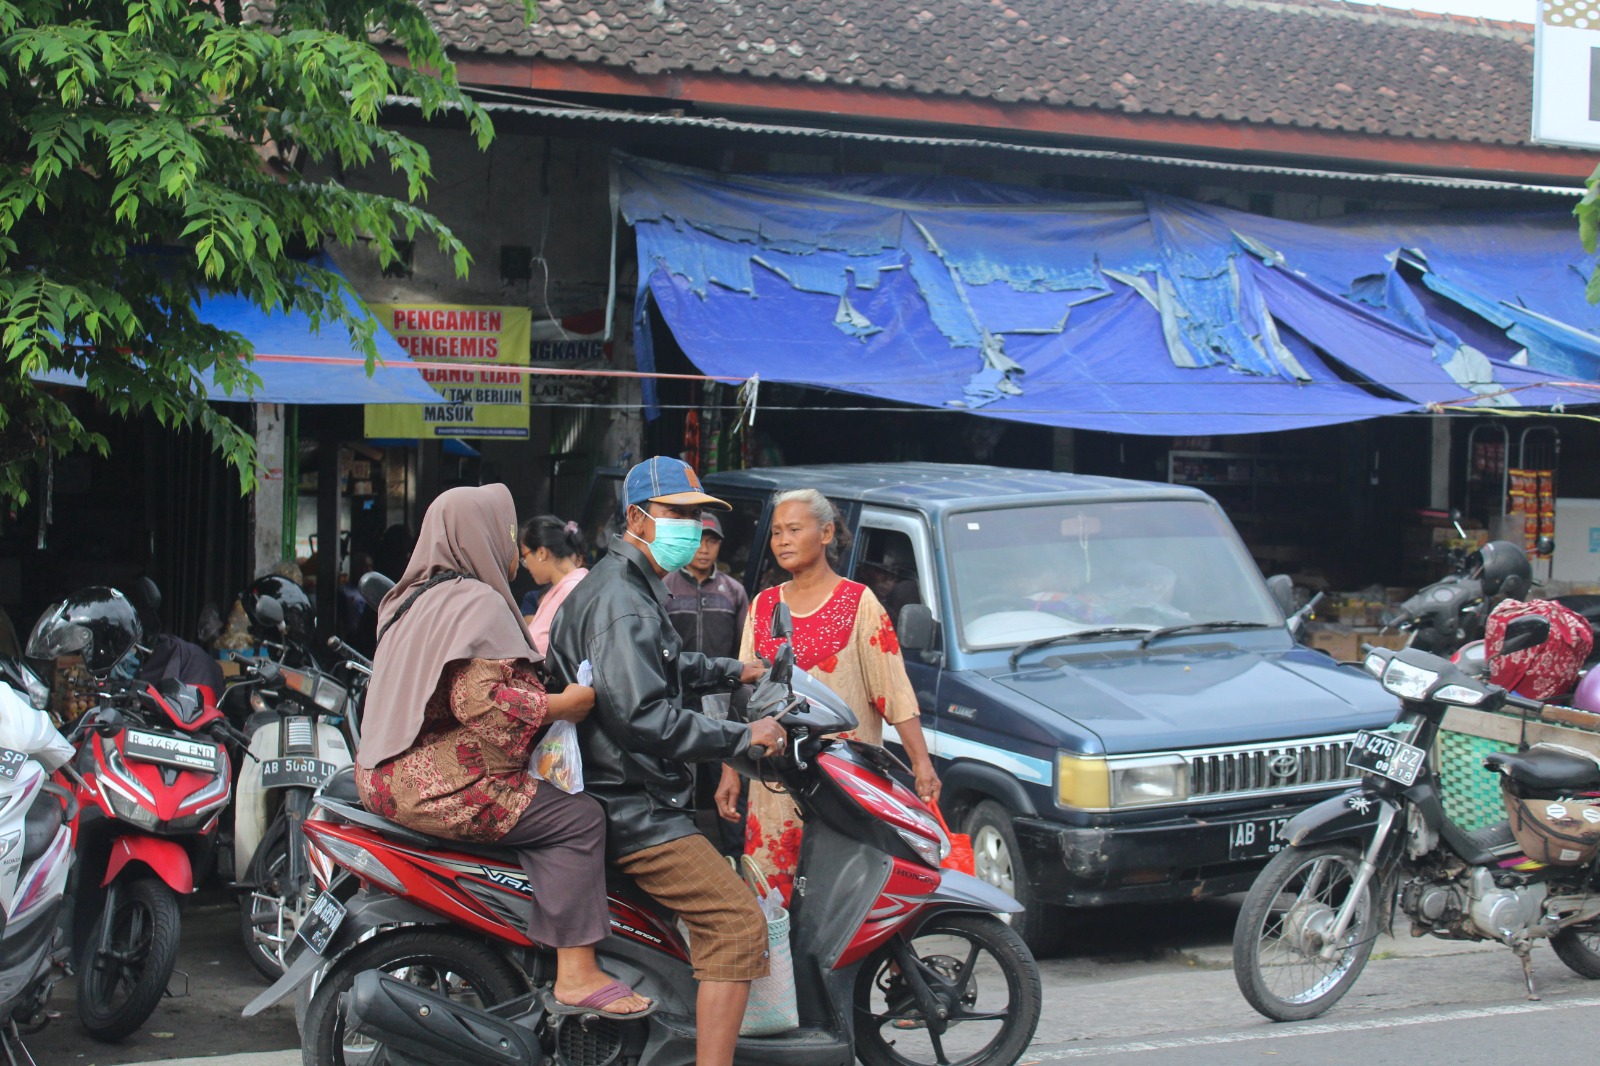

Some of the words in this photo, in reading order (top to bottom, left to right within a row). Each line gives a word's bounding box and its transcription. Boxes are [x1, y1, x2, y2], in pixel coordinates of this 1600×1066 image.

[393, 309, 502, 332] PENGAMEN
[397, 336, 498, 358] PENGEMIS
[418, 364, 475, 383] GANG
[480, 363, 521, 384] LIAR
[449, 388, 473, 402] TAK
[475, 389, 522, 404] BERIJIN
[424, 405, 474, 422] MASUK
[2, 750, 24, 764] SP
[1367, 736, 1395, 757] 4276
[264, 761, 279, 775] AB
[1234, 822, 1256, 847] AB
